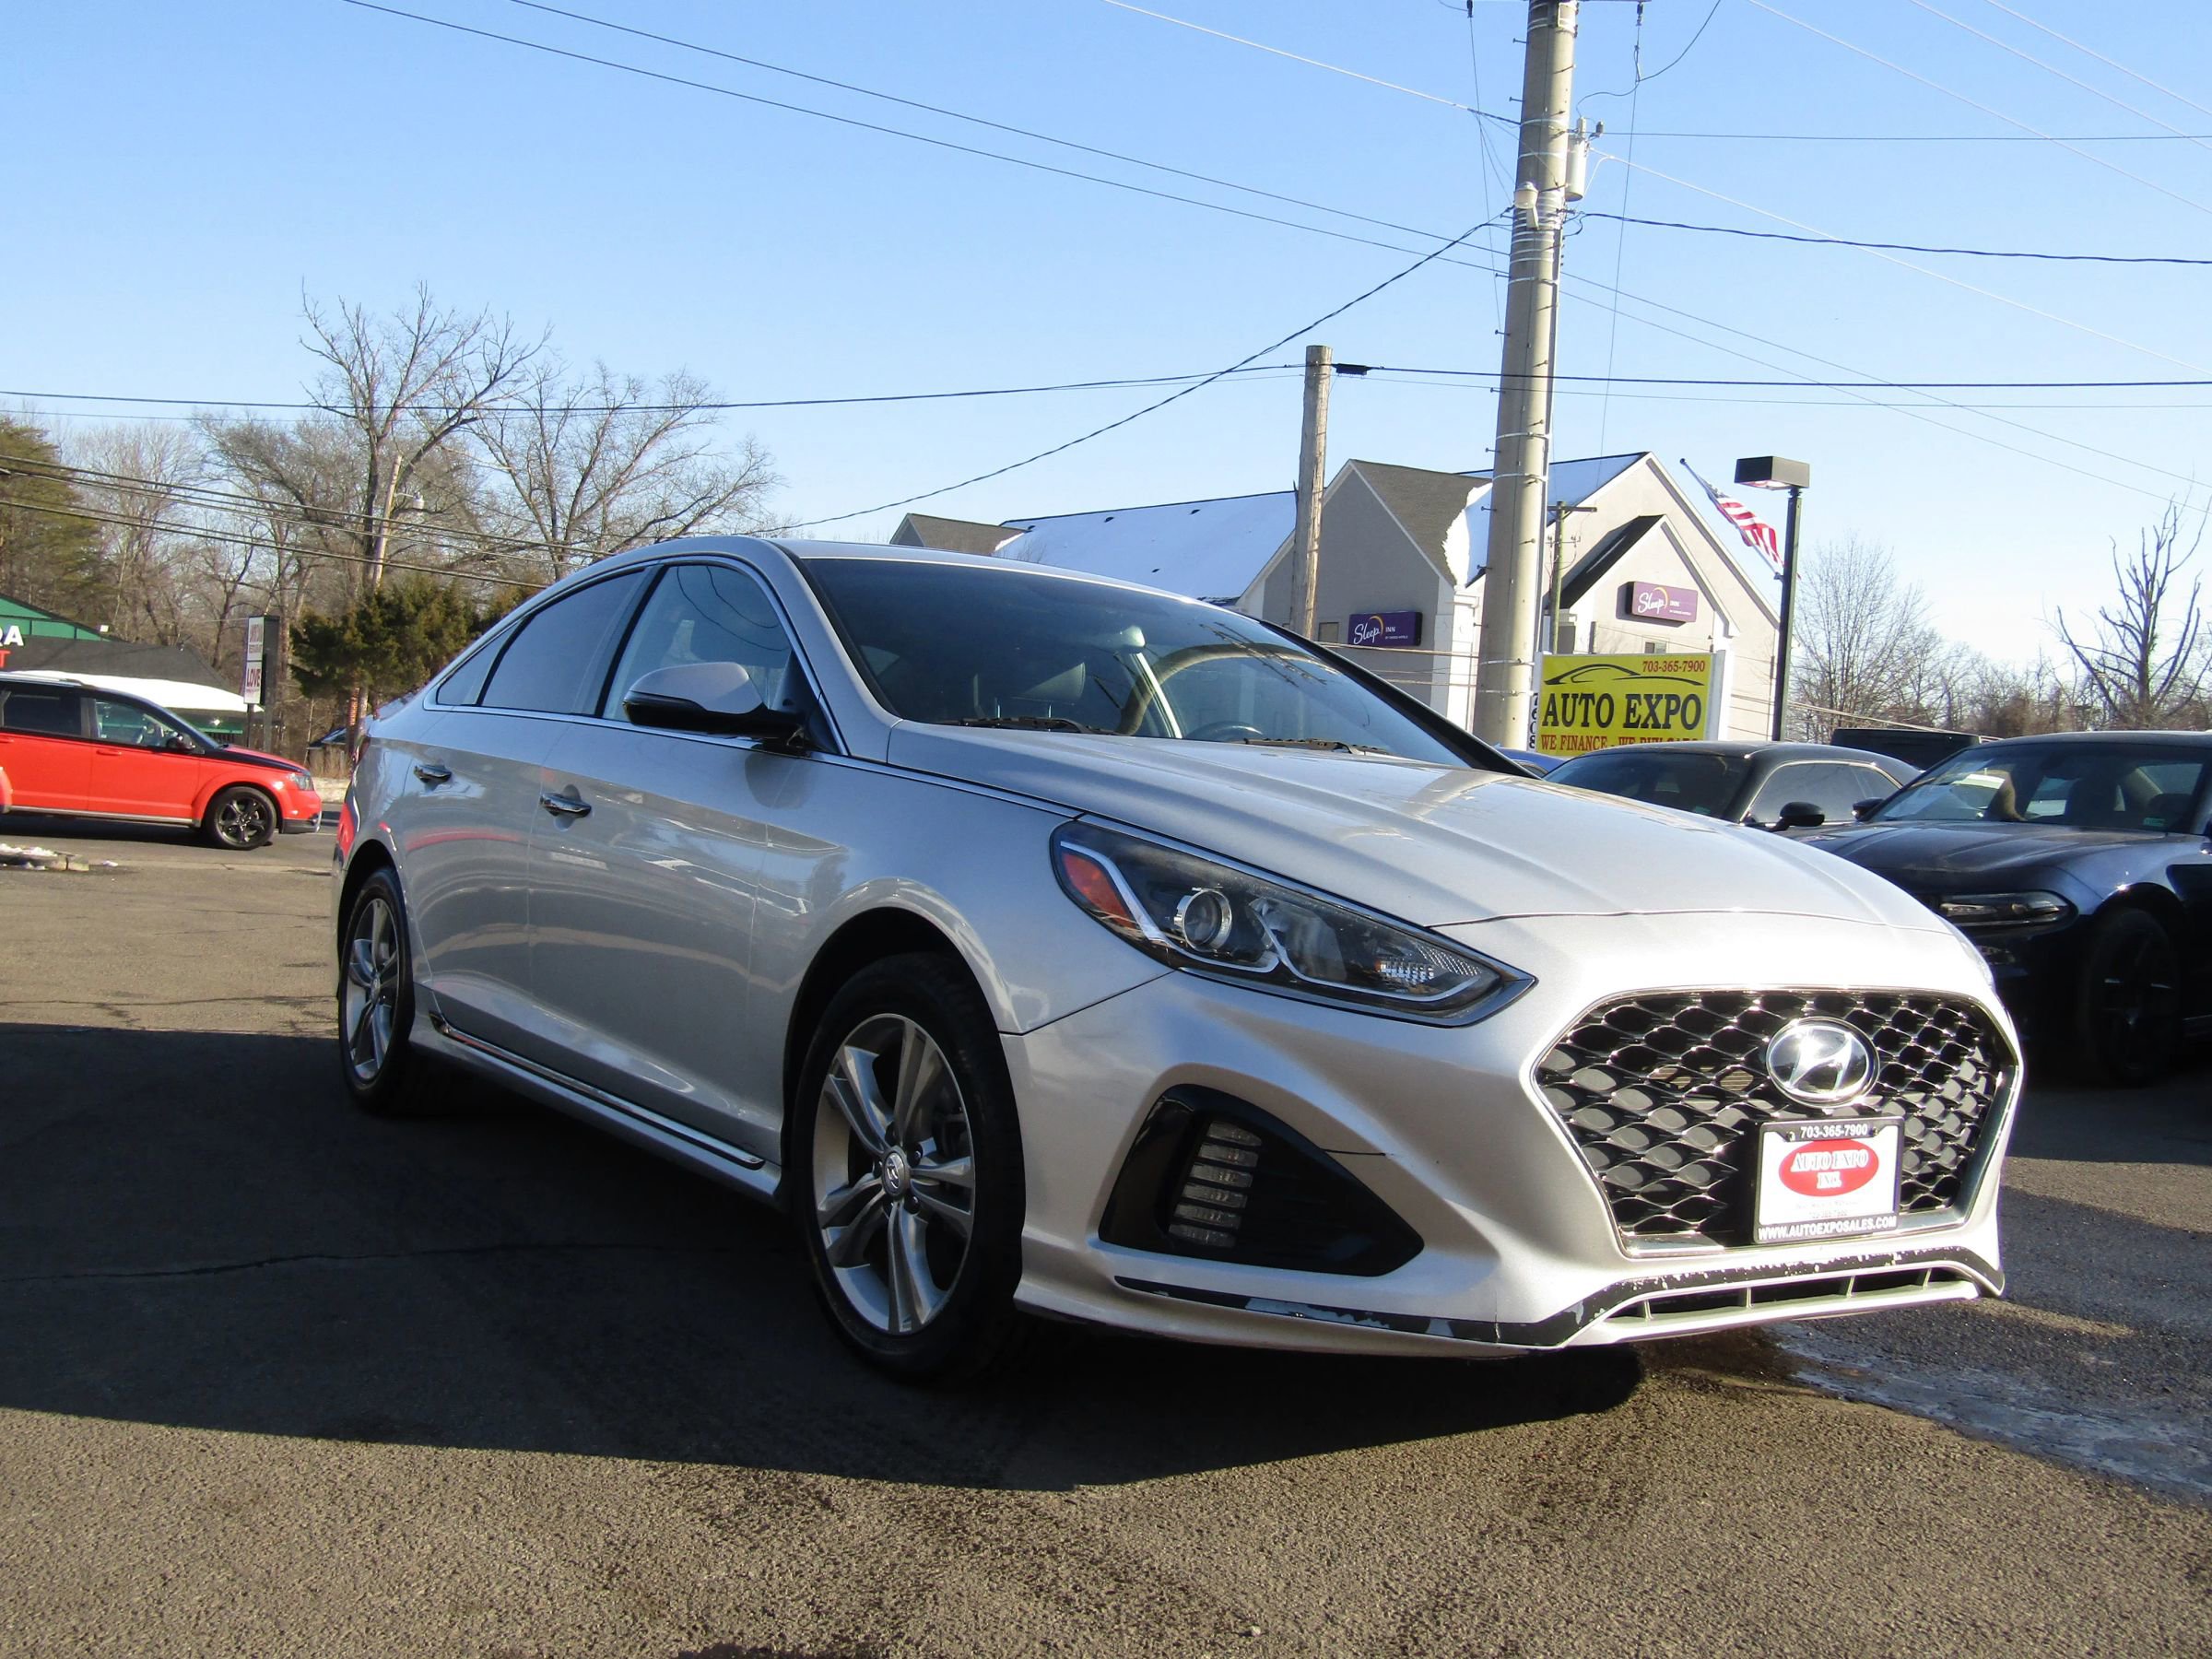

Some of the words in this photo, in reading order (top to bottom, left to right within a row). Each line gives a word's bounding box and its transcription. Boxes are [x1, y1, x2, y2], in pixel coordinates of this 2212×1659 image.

[1638, 592, 1666, 615] Sleep
[1353, 621, 1381, 645] Sleep
[246, 668, 261, 688] LOVE
[1642, 660, 1705, 673] 703-365-7900
[1541, 692, 1615, 728] AUTO
[1623, 693, 1702, 731] EXPO
[1541, 735, 1557, 750] WE
[1560, 735, 1607, 752] FINANCE
[1800, 1124, 1868, 1139] 703-365-7900
[1791, 1151, 1832, 1171] AUTO
[1831, 1148, 1869, 1171] EXPO
[1758, 1217, 1897, 1241] WWW.AUTOEXPOSALES.COM
